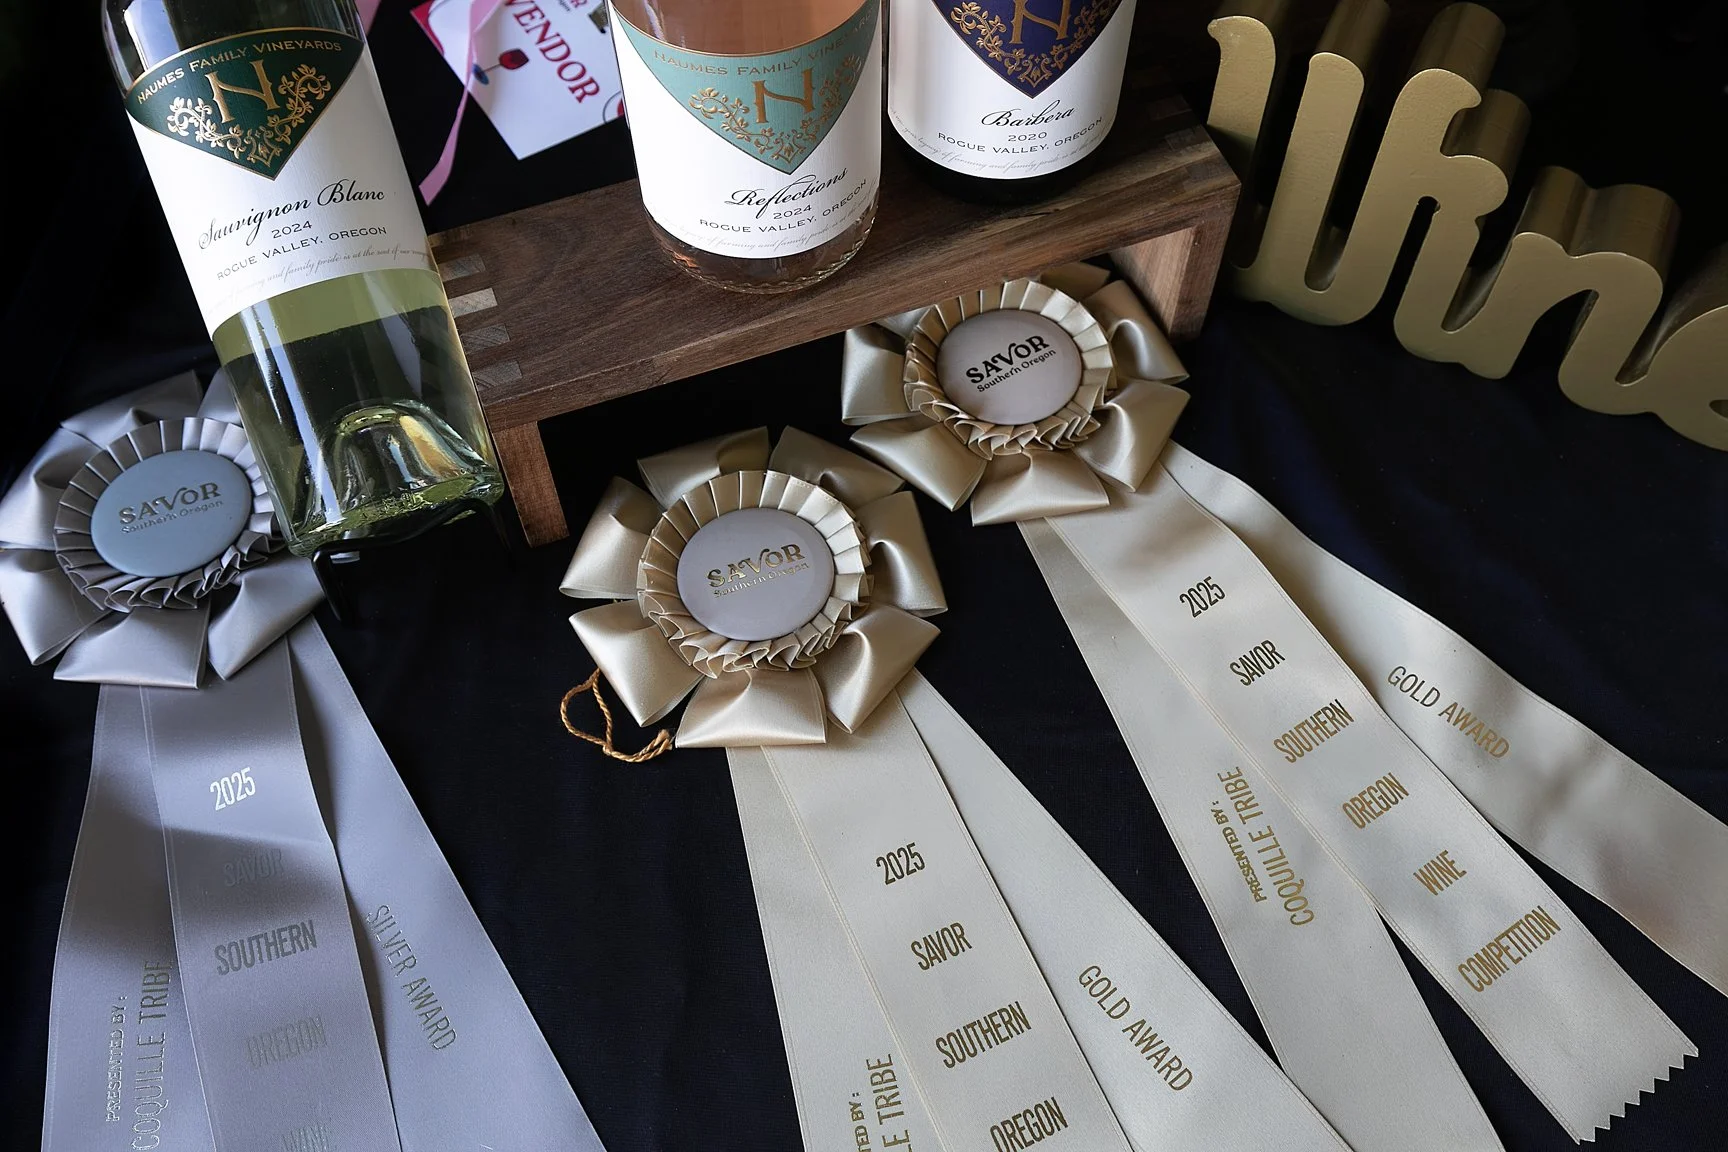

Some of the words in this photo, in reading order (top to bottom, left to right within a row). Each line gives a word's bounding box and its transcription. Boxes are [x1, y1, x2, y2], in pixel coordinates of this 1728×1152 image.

[654, 50, 729, 75] NAUMES
[737, 57, 801, 76] FAMILY
[808, 7, 873, 61] VINEARD
[1009, 0, 1071, 45] N
[136, 67, 185, 105] NAUMES
[189, 47, 248, 73] FAMILY
[252, 39, 342, 55] VINEYARDS
[205, 59, 281, 124] N
[753, 66, 816, 124] N
[938, 132, 986, 153] ROGUE
[1054, 117, 1103, 147] OREGON
[981, 99, 1076, 127] Barbera
[1008, 131, 1047, 142] 2020
[199, 198, 311, 250] Sauvignon
[317, 178, 385, 207] Blanc
[699, 218, 752, 234] ROGUE
[822, 178, 868, 217] OREGON
[724, 166, 848, 220] Reflections
[773, 204, 812, 220] 2024
[217, 255, 258, 281] ROGUE
[328, 226, 388, 241] OREGON
[272, 220, 312, 239] 2024
[282, 259, 315, 288] family
[313, 254, 341, 275] pride
[966, 334, 1051, 385] SAVOR
[977, 367, 1022, 393] Southern
[1021, 348, 1057, 370] Oregon
[118, 481, 222, 526] SAVOR
[121, 512, 179, 535] Southern
[179, 499, 225, 518] Oregon
[706, 543, 807, 589] SAVOR
[713, 575, 768, 599] Southern
[767, 562, 811, 580] Oregon
[1178, 576, 1226, 619] 2025
[1229, 638, 1286, 687] SAVOR
[1273, 698, 1355, 764] SOUTHERN
[1387, 665, 1442, 709] GOLD
[1438, 701, 1511, 760] AWARD
[209, 766, 257, 812] 2025
[1217, 766, 1264, 825] TRIBE
[1342, 772, 1410, 830] OREGON
[223, 847, 287, 888] SAVOR
[875, 841, 926, 886] 2025
[1222, 826, 1268, 903] PRESENTED
[1248, 825, 1315, 926] COQUILLE
[1413, 850, 1468, 897] WINE
[214, 919, 319, 978] SOUTHERN
[910, 921, 972, 972] SAVOR
[1457, 904, 1562, 993] COMPETITION
[138, 960, 173, 1025] TRIBE
[366, 903, 418, 979] SILVER
[401, 976, 457, 1053] AWARD
[246, 1014, 328, 1071] OREGON
[935, 1000, 1032, 1069] SOUTHERN
[1077, 964, 1131, 1021] GOLD
[1121, 1018, 1194, 1093] AWARD
[105, 1028, 125, 1123] PRESENTED
[131, 1031, 169, 1151] COQUILLE
[865, 1053, 905, 1126] TRIBE
[989, 1096, 1069, 1152] OREGON
